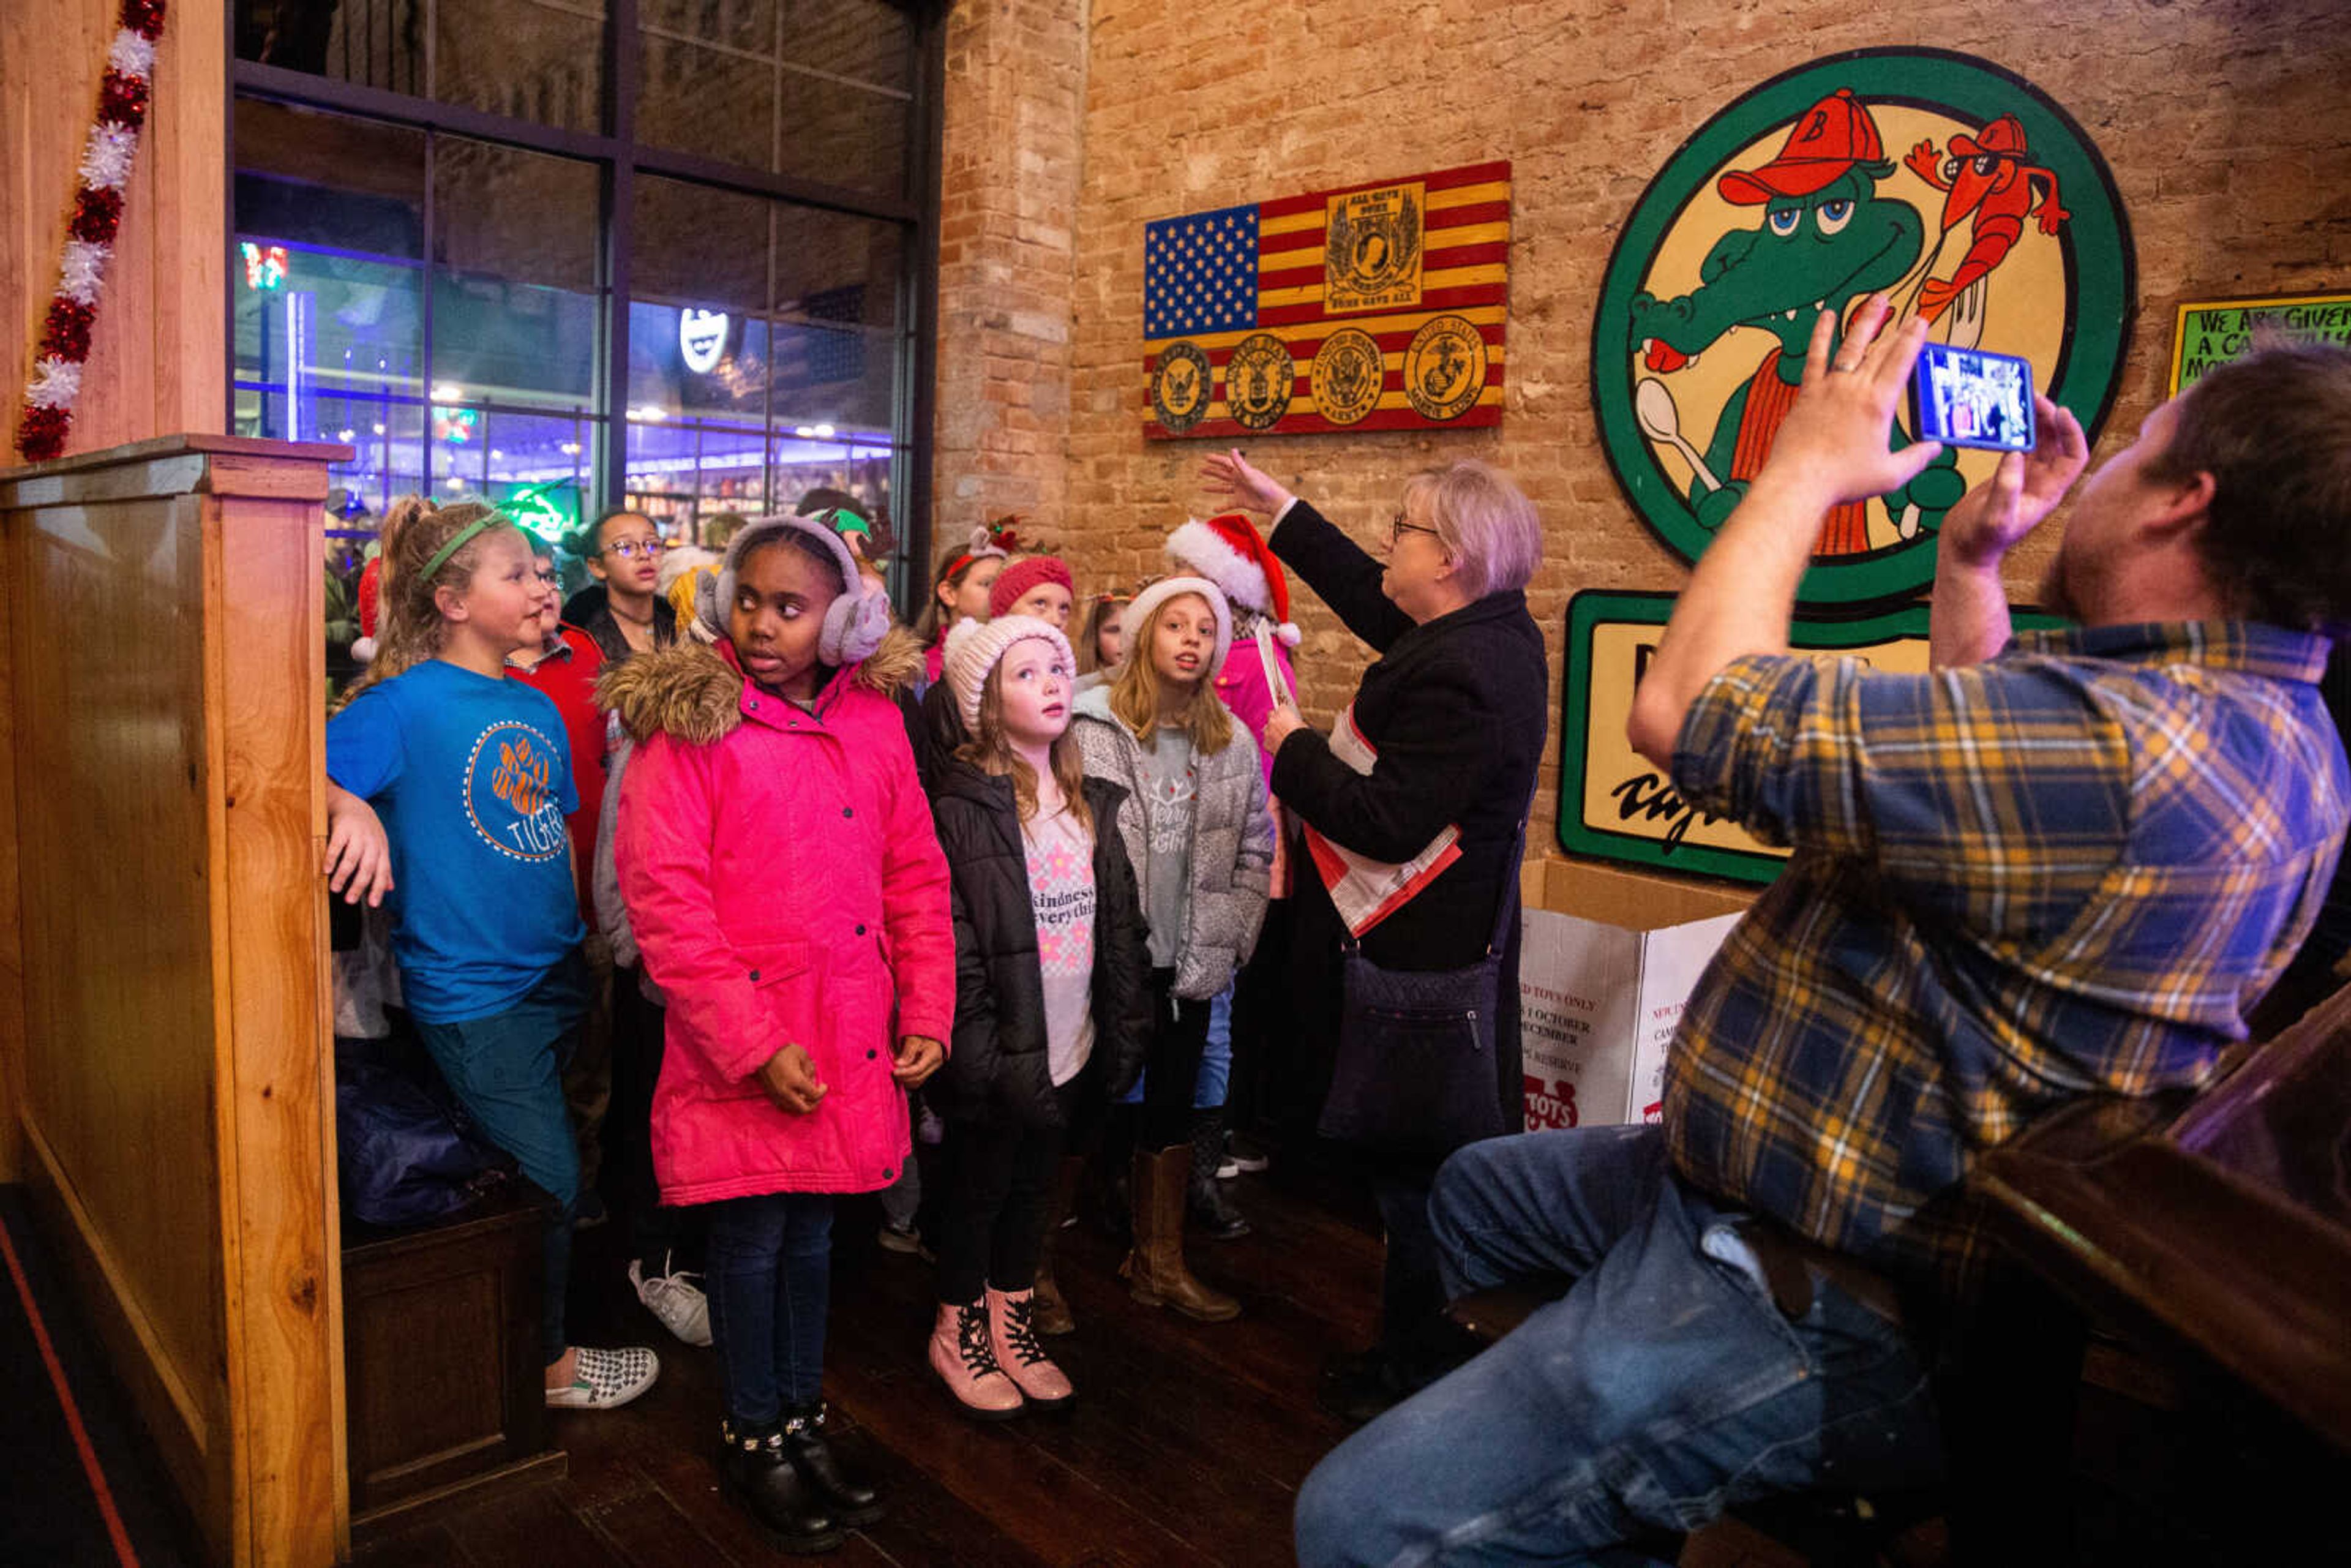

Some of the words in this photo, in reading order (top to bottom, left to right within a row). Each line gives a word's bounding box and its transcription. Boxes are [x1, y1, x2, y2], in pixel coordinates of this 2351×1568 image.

[1799, 111, 1828, 142] B
[2200, 312, 2230, 333] WE
[2199, 336, 2212, 355] A
[1611, 773, 1719, 855] Caj
[1521, 1021, 1578, 1045] ECEMBER
[1535, 1010, 1591, 1033] OCTOBER
[1525, 1093, 1570, 1127] TOTS
